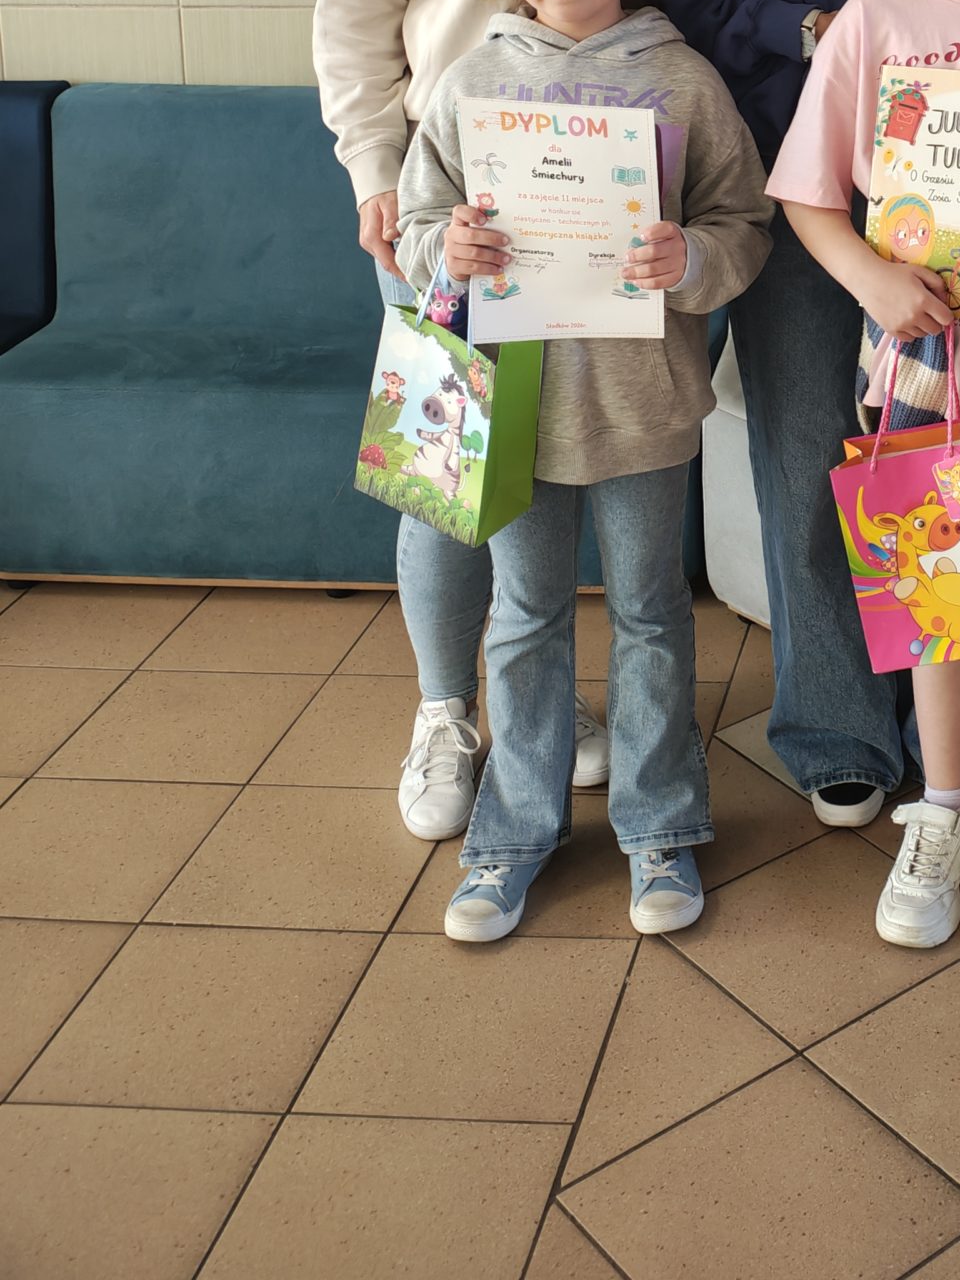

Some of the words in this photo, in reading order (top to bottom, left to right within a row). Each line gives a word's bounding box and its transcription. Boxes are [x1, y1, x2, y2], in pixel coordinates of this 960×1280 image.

[500, 111, 609, 139] DYPLOM
[548, 144, 562, 154] dla
[541, 156, 572, 167] Amelii
[531, 167, 585, 184] Śmiechury
[910, 169, 918, 182] O
[922, 170, 955, 184] Grzesiu
[529, 193, 560, 202] zajęcie
[571, 196, 604, 205] miejsca
[928, 188, 951, 203] Zosia
[510, 246, 554, 257] Organizatorzy
